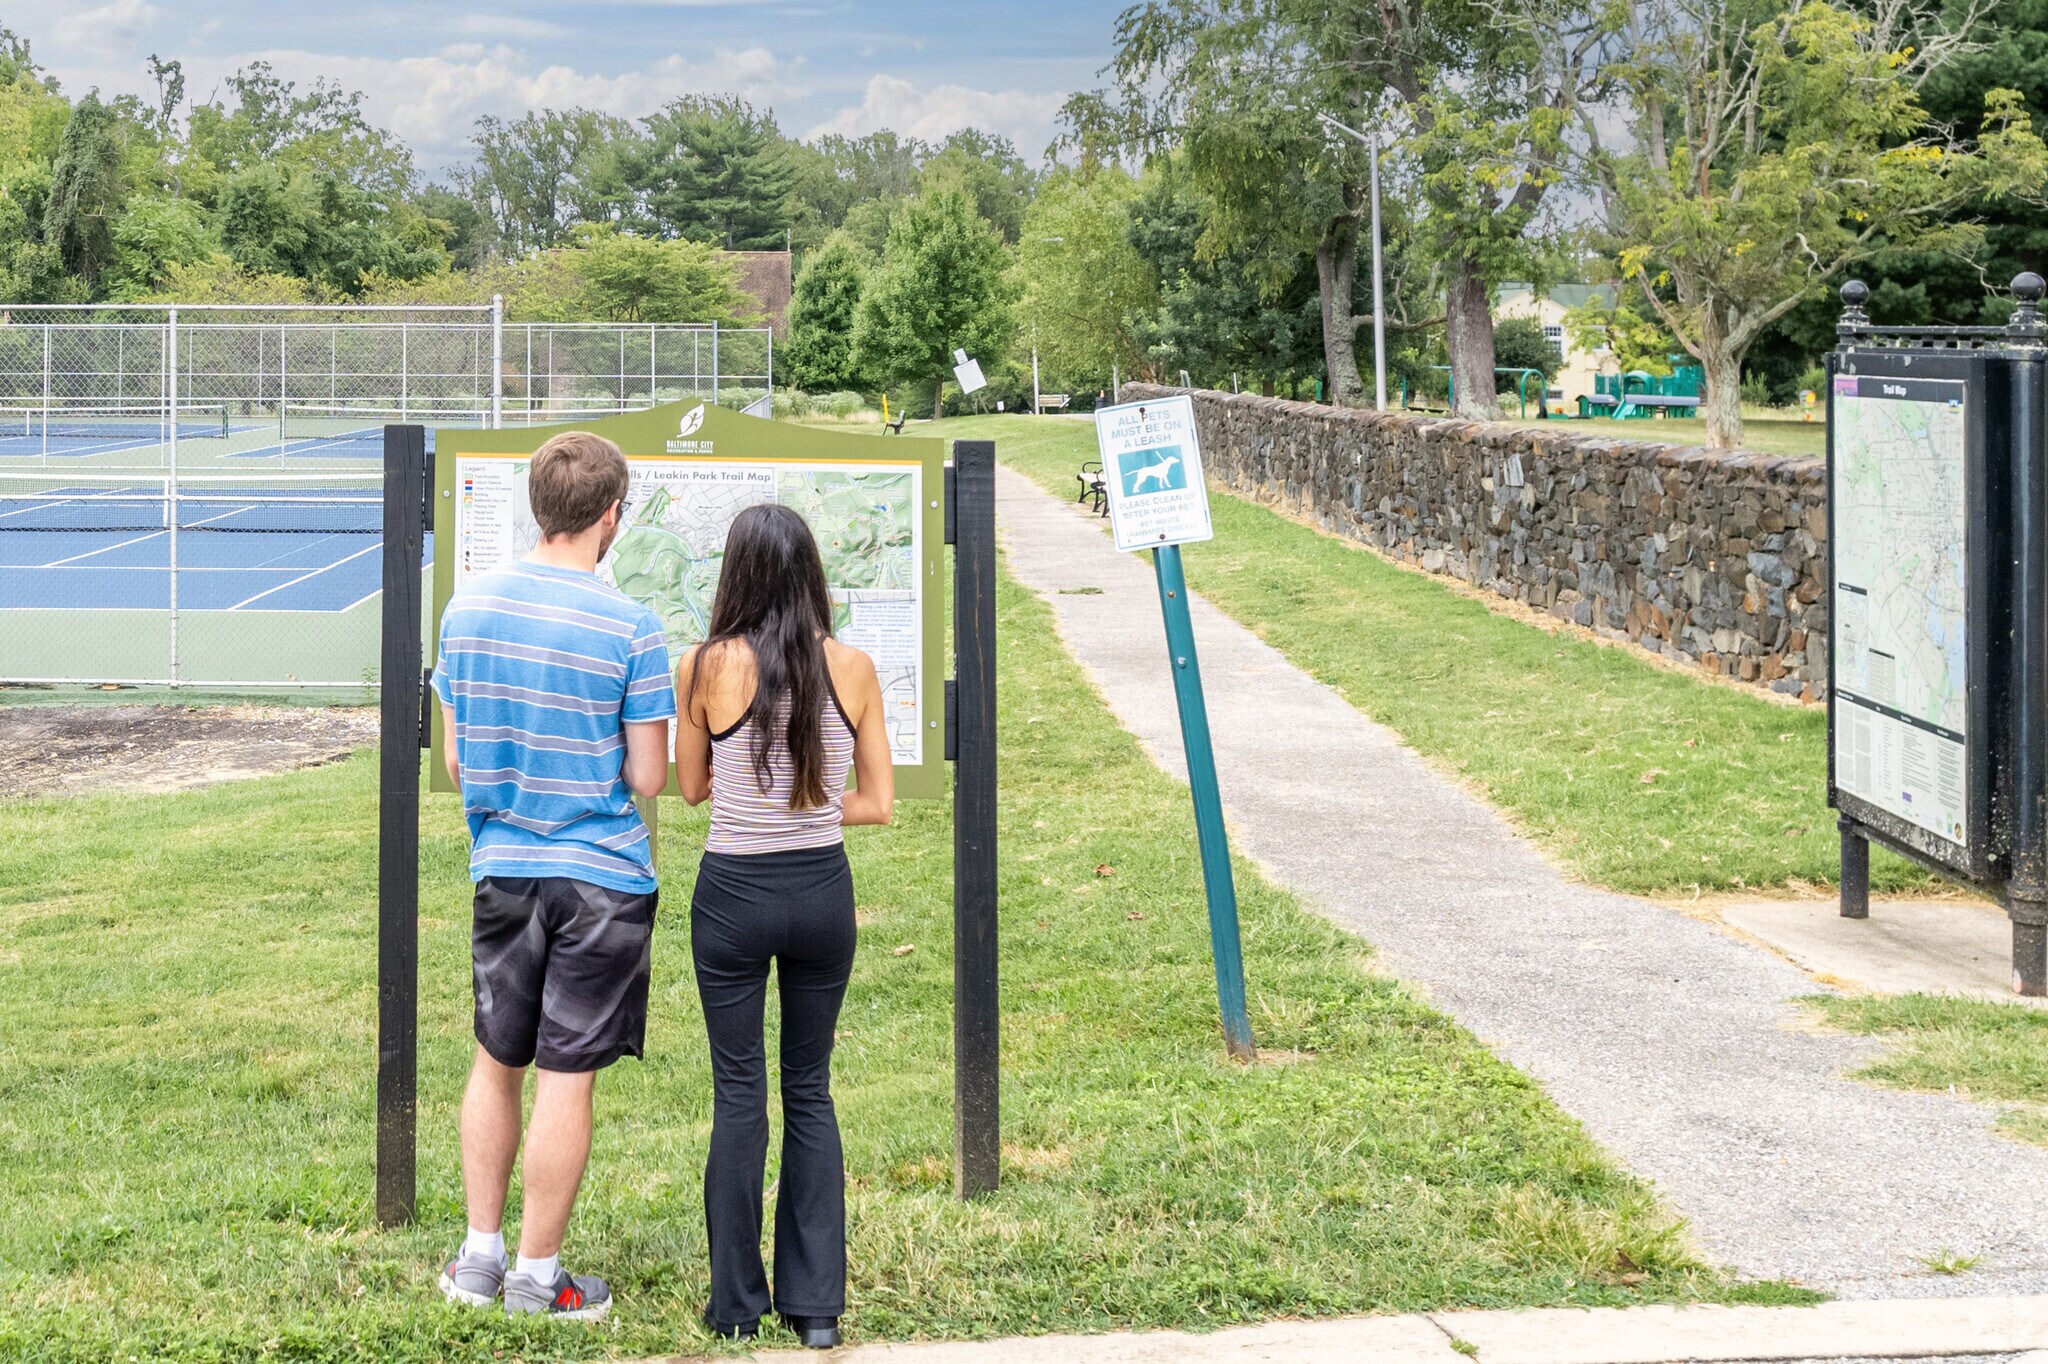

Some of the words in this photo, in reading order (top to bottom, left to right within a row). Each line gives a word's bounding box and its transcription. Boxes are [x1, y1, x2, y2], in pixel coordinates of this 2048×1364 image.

[1883, 384, 1894, 394] Trail
[1895, 386, 1907, 397] Map
[1118, 415, 1138, 426] ALL
[1142, 410, 1170, 422] PETS
[1112, 426, 1142, 439] MUST
[1146, 423, 1162, 433] BE
[1164, 420, 1181, 430] ON
[666, 440, 698, 448] BALTIMORE
[1124, 440, 1131, 448] A
[1135, 434, 1172, 446] LEASH
[630, 470, 642, 479] lls
[645, 470, 651, 480] /
[654, 471, 689, 480] Leakin
[693, 471, 717, 480] Park
[721, 472, 743, 480] Trail
[747, 473, 771, 482] Map
[1119, 498, 1151, 510] PLEASE
[1153, 495, 1182, 504] CLEAN
[1152, 505, 1176, 515] YOUR
[1178, 503, 1195, 511] PET
[1156, 516, 1180, 525] WASTE
[1126, 527, 1165, 537] TRANSMITS
